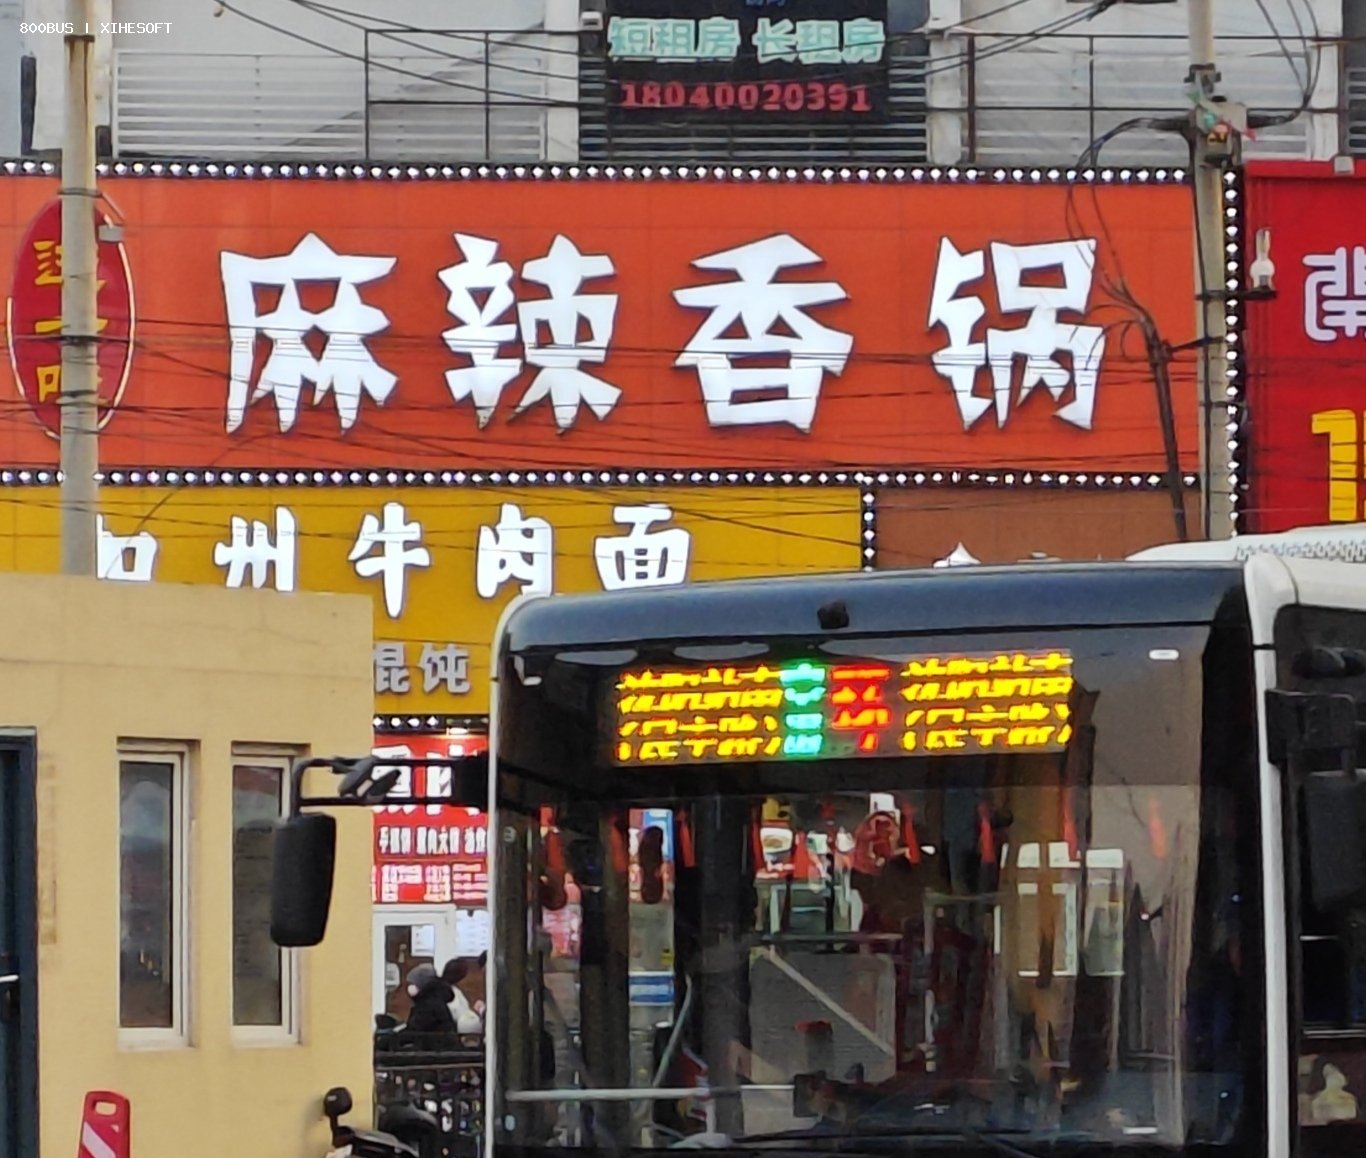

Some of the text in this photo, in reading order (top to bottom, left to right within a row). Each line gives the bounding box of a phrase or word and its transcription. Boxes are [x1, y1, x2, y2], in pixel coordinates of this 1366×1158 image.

[607, 16, 886, 64] 短租房 长租房
[620, 80, 872, 111] 18040020391
[221, 233, 1105, 432] 麻辣香锅
